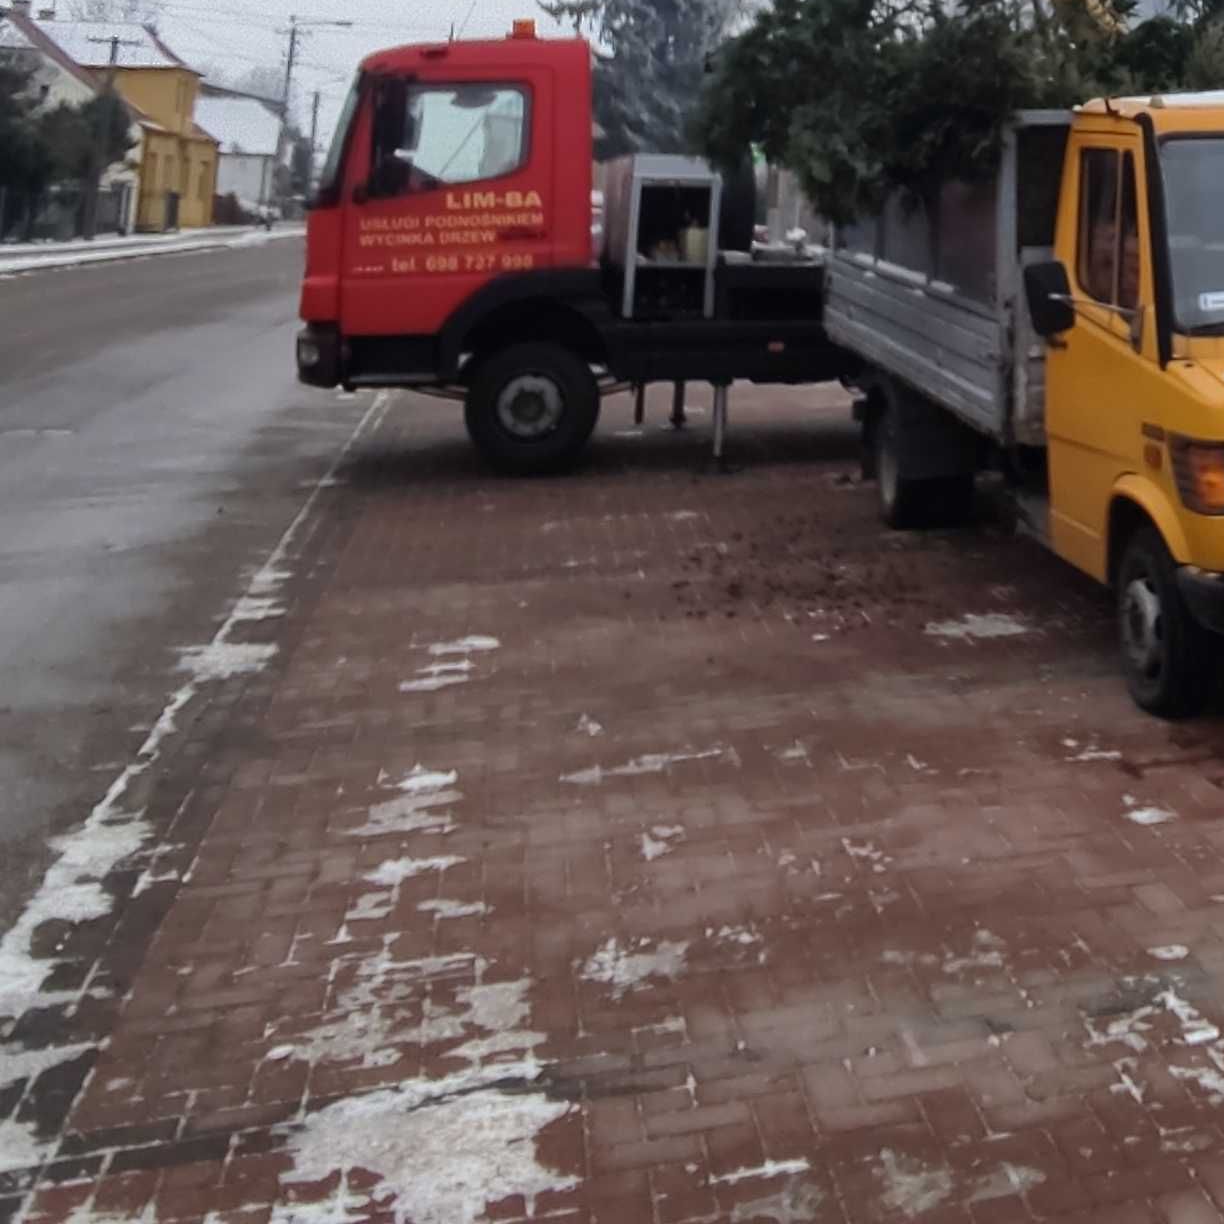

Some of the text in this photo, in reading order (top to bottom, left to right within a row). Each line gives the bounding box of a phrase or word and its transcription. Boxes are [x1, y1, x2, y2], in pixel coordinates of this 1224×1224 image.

[446, 191, 542, 209] LIM-BA
[360, 212, 543, 231] USŁUGI PODNOŚNIKIEM
[360, 230, 496, 246] WYCINKA DRZEW
